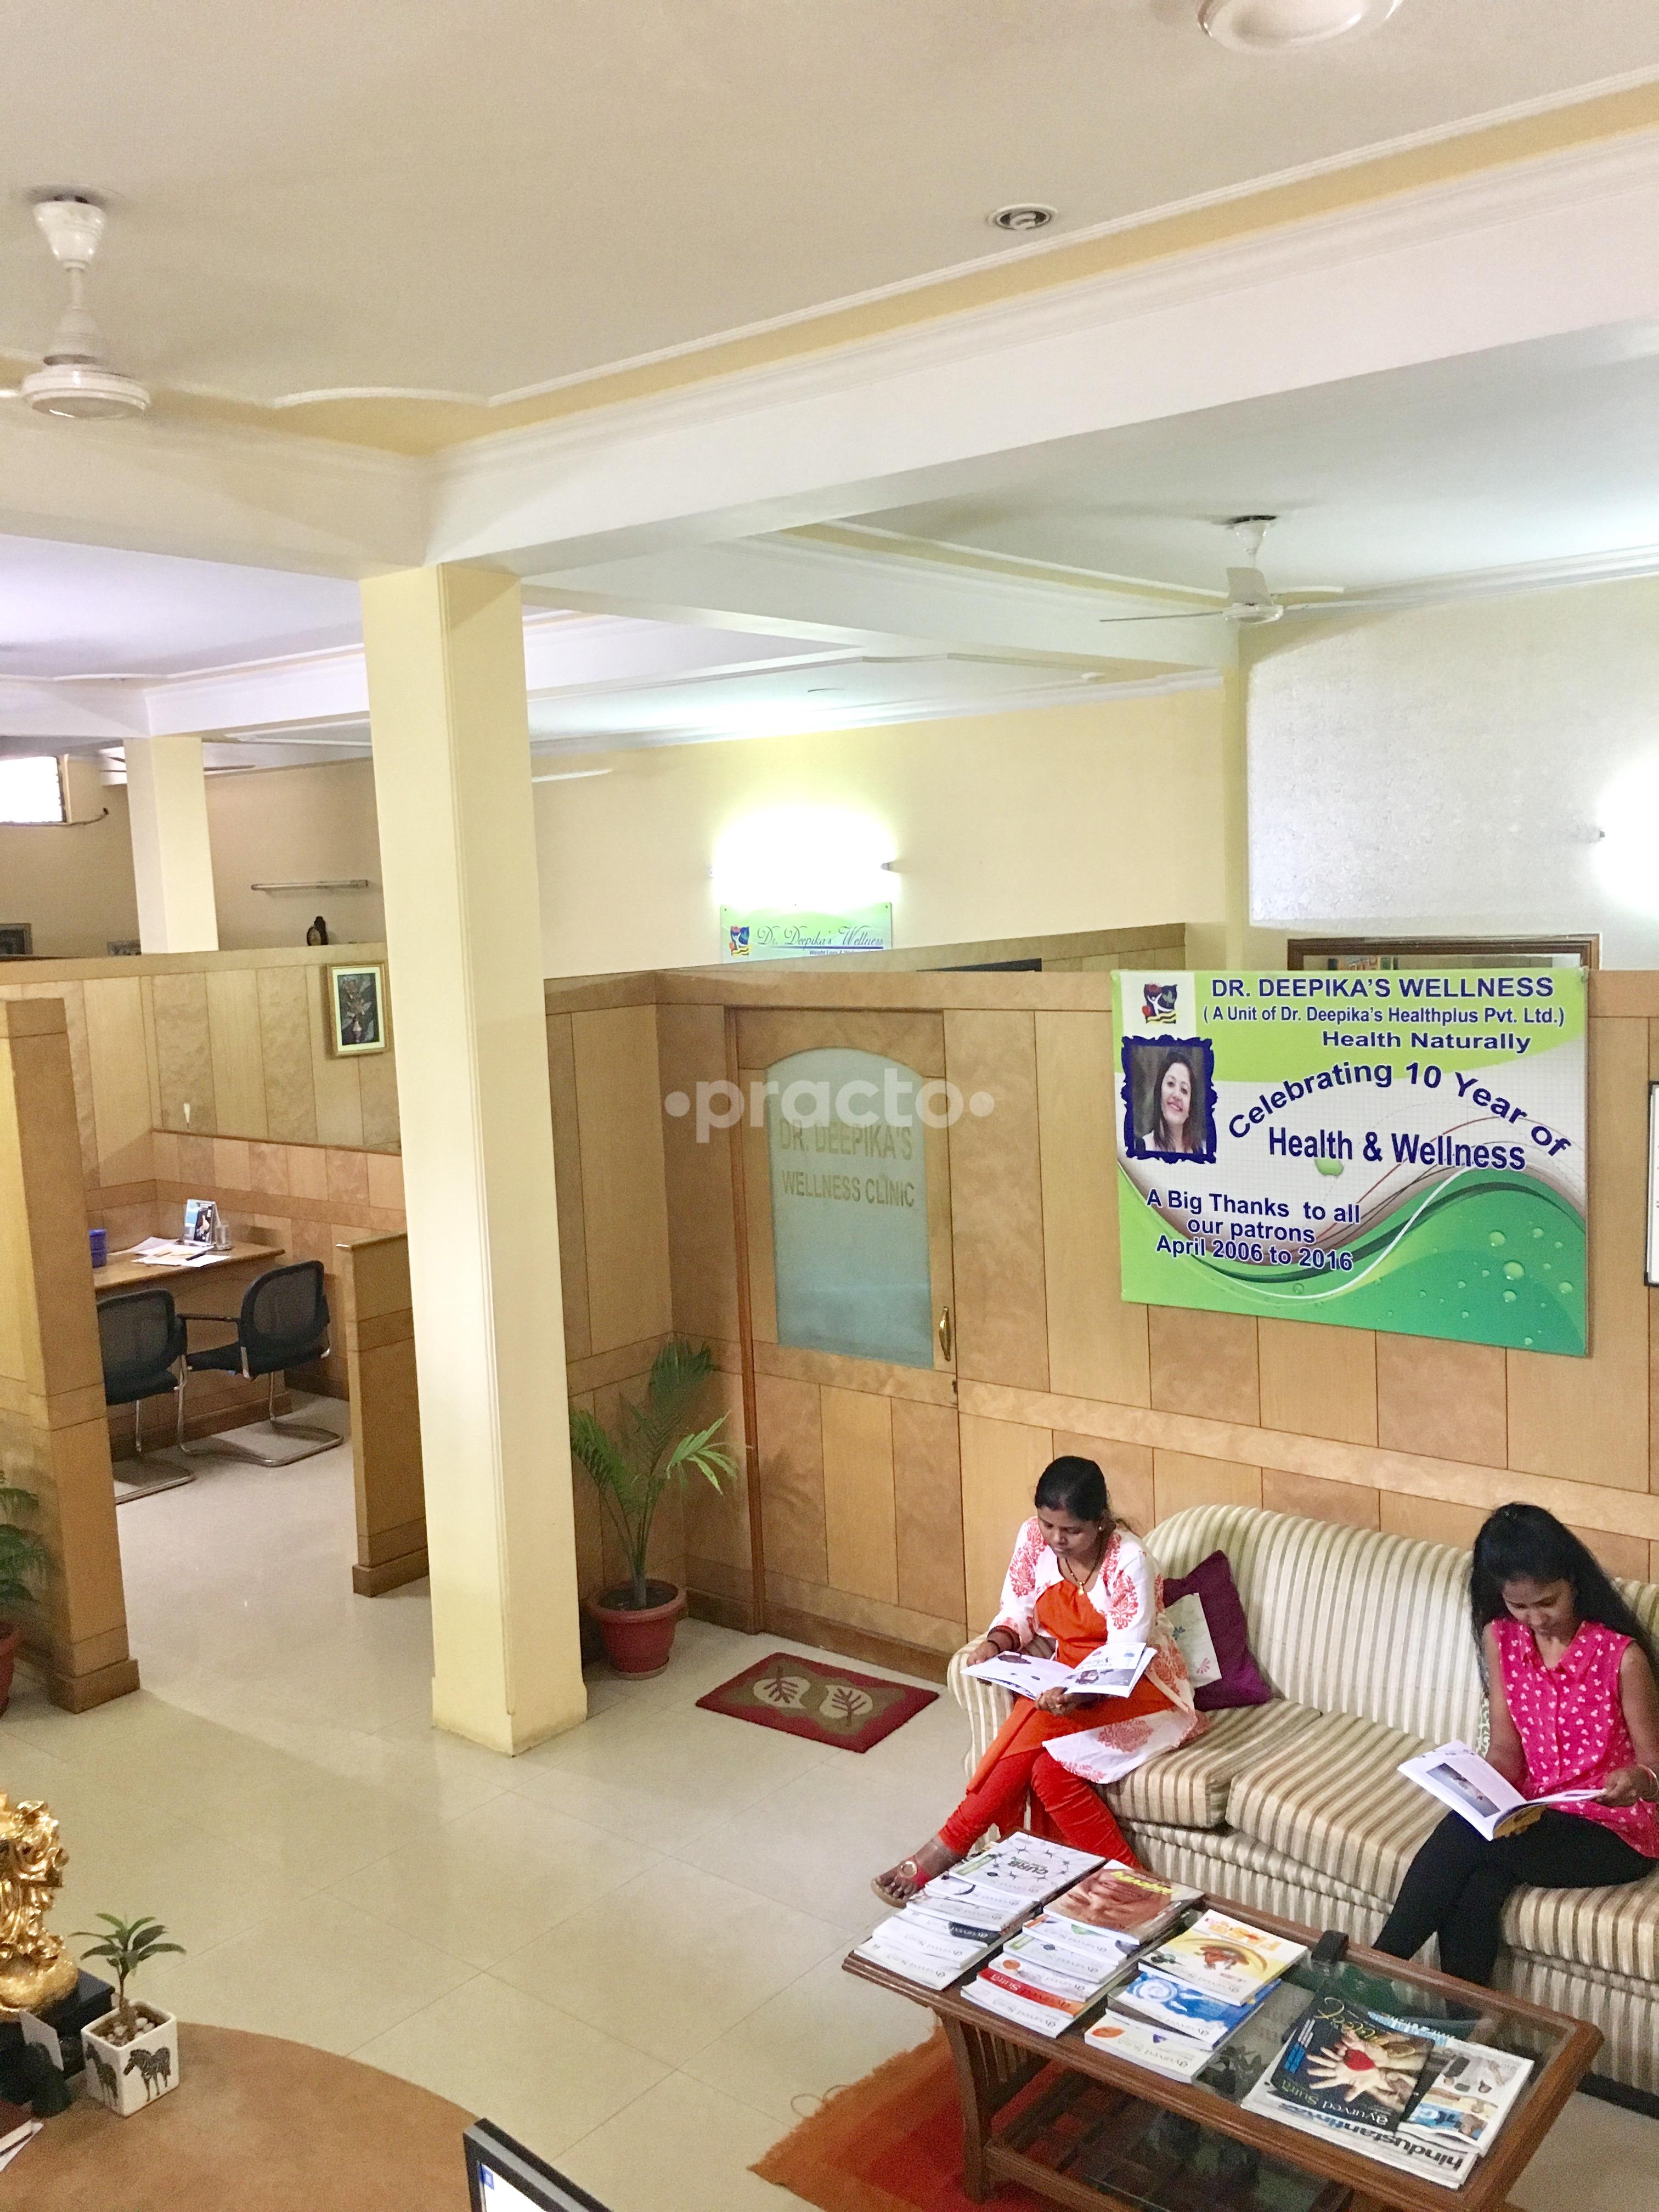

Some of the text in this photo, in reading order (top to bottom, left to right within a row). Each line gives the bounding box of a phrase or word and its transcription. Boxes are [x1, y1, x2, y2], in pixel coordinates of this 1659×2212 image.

[838, 925, 883, 946] Wellness
[1212, 977, 1553, 997] DR. DEEPIKA'S WELLNESS
[1227, 1006, 1257, 1021] Unit
[1261, 1006, 1277, 1021] of
[1280, 1006, 1302, 1022] Dr.
[1306, 1006, 1383, 1025] Deepika's
[1389, 1007, 1479, 1025] Healthplus
[1485, 1007, 1518, 1024] Pvt.
[1523, 1007, 1565, 1027] Ltd.)
[1322, 1031, 1532, 1054] Health Naturally
[1228, 1062, 1571, 1157] Celebrating 10 Year of
[1269, 1127, 1525, 1170] Health & Wellness
[782, 1170, 915, 1207] WELLNESS CLINIC
[1147, 1189, 1359, 1223] A Big Thanks to all
[1188, 1219, 1315, 1245] our patrons
[1156, 1233, 1352, 1271] April 2006 to 2016
